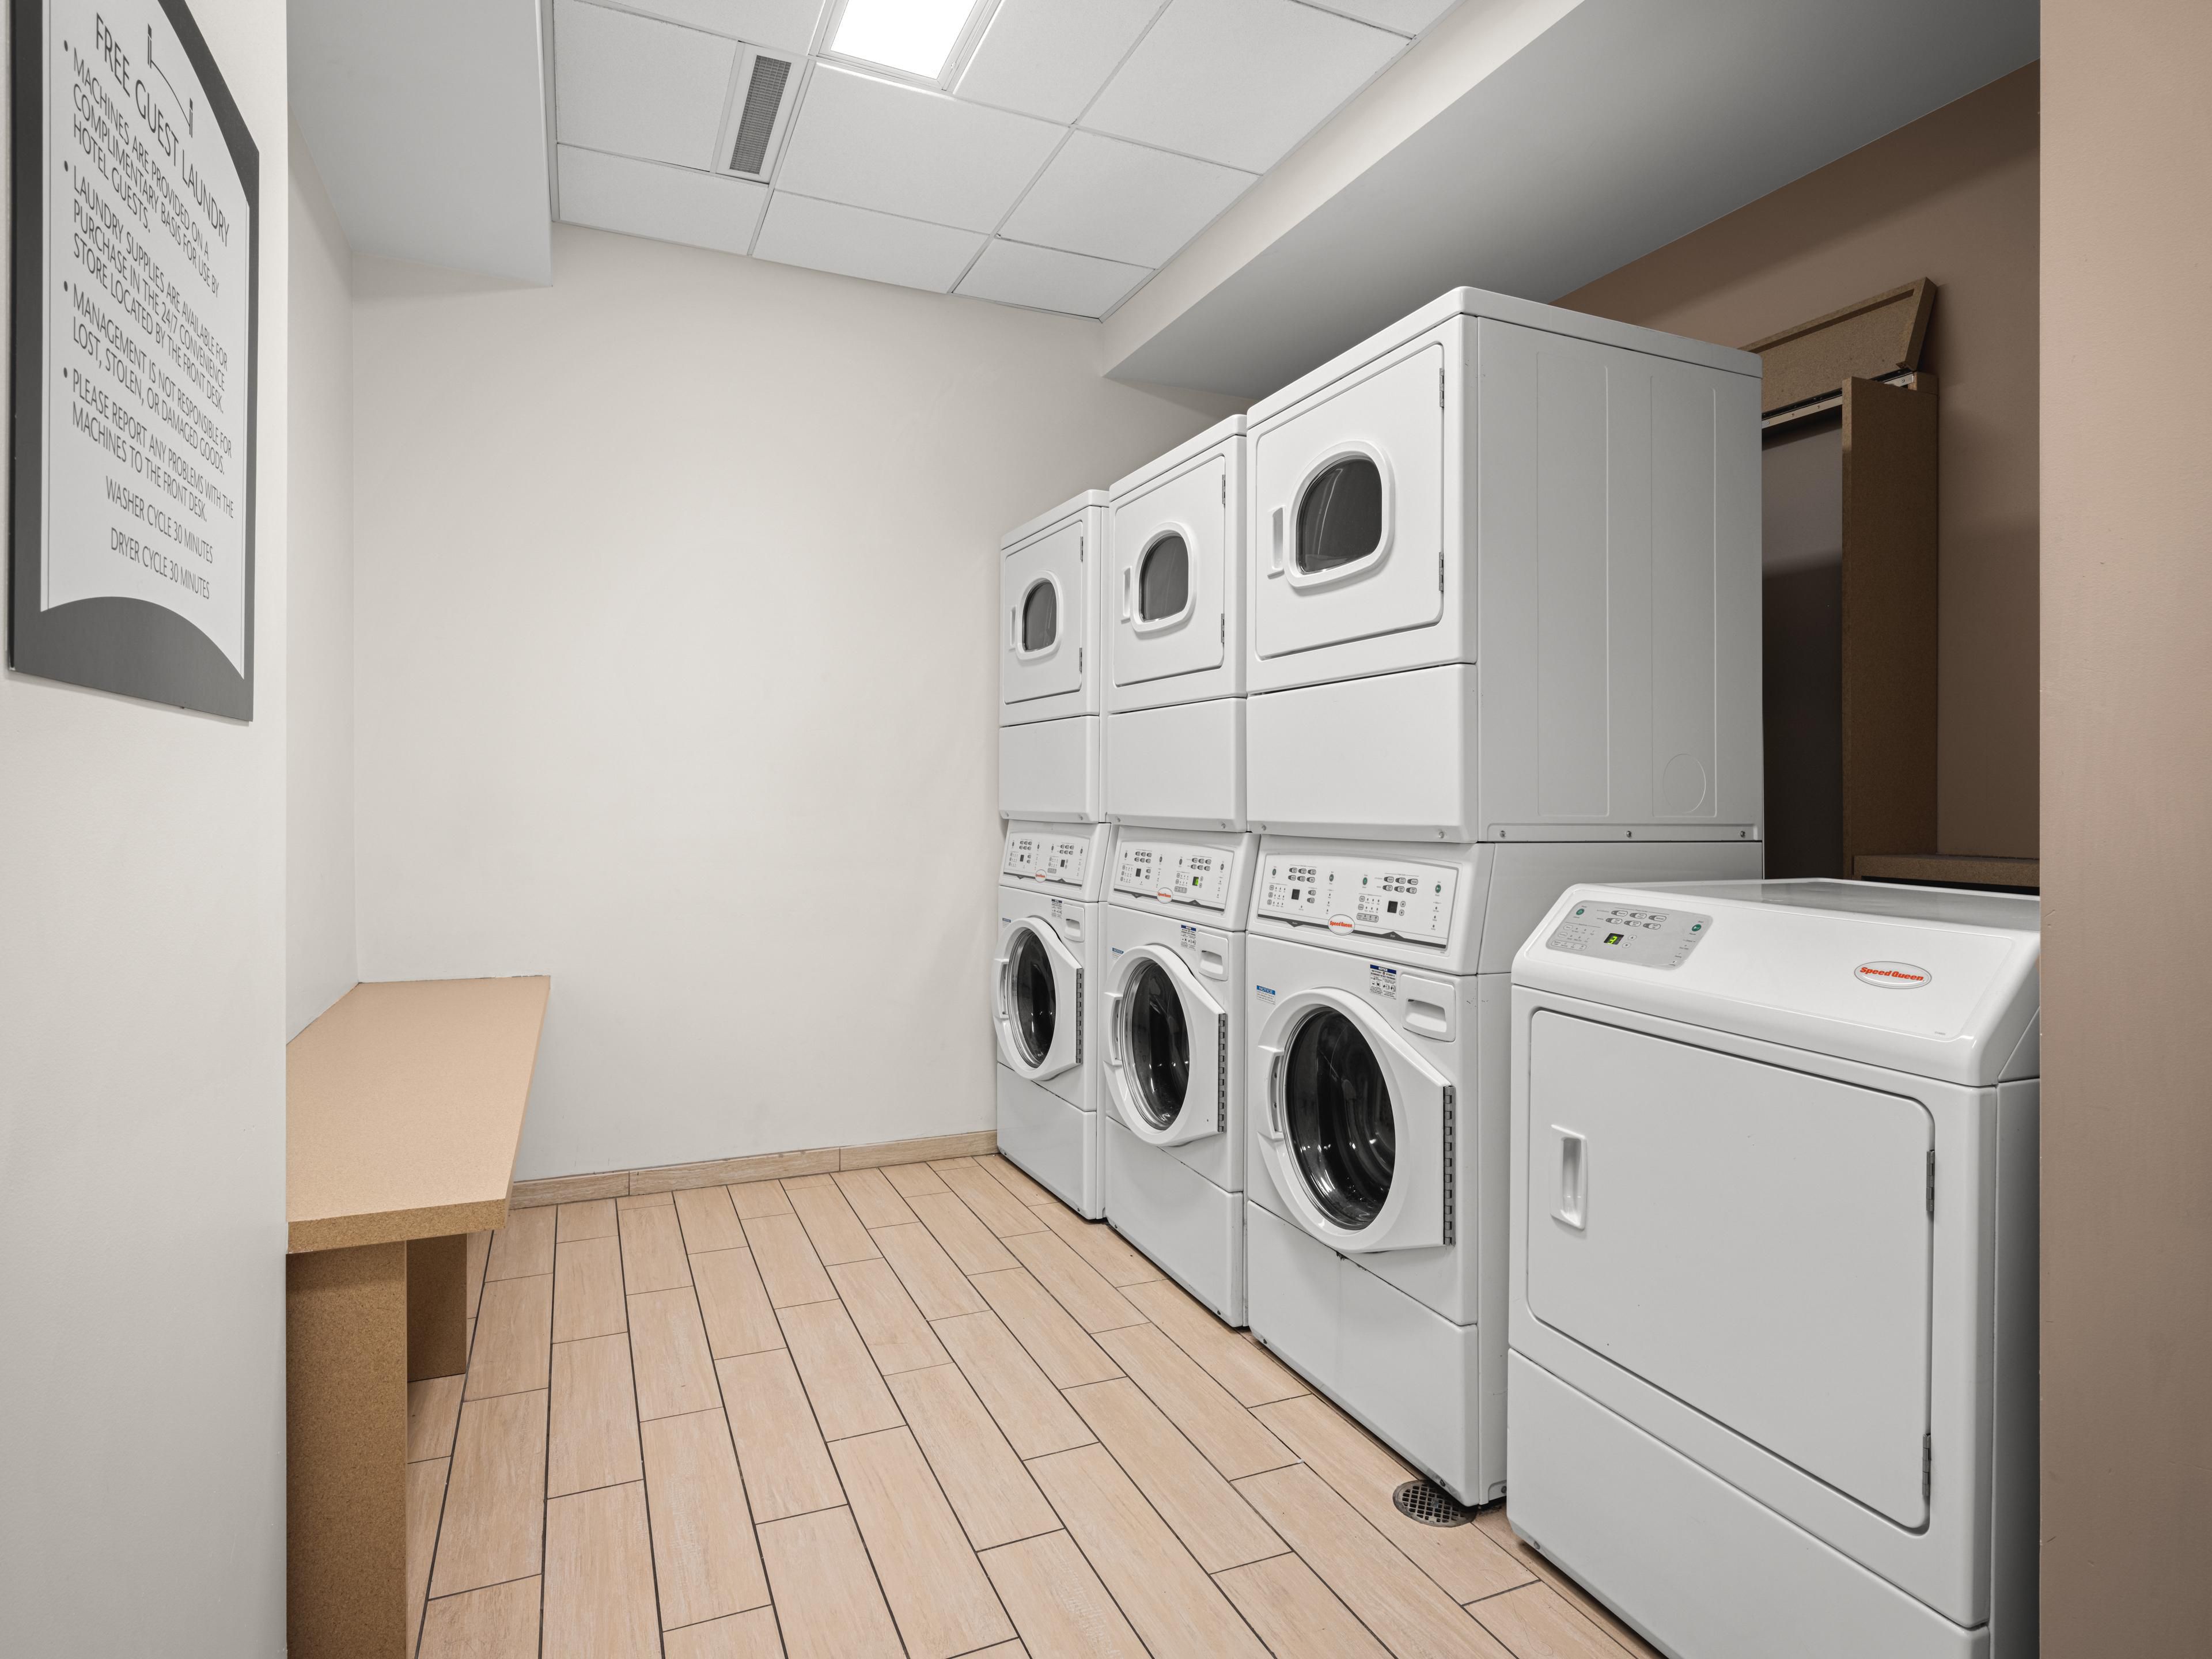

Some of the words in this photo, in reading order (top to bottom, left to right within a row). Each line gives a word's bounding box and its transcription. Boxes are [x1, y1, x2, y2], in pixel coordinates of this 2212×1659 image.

[73, 83, 159, 214] COMPLIMENTARY
[161, 200, 181, 246] BASIS
[183, 233, 197, 269] FOR
[198, 255, 210, 287] USE
[211, 274, 219, 298] BY
[74, 47, 130, 146] MACHINES
[131, 135, 150, 175] ARE
[151, 160, 190, 231] PROVIDED
[191, 221, 203, 252] ON
[203, 240, 209, 262] A
[74, 113, 109, 181] HOTEL
[111, 166, 150, 233] GUESTS.
[96, 12, 131, 98] FREE
[135, 79, 179, 167] GUEST
[182, 149, 230, 247] LAUNDRY
[73, 232, 108, 290] STORE
[111, 272, 153, 335] LOCATED
[156, 321, 166, 349] BY
[166, 334, 182, 369] THE
[183, 353, 206, 393] FRONT
[206, 379, 224, 414] DESK.
[74, 165, 124, 244] LAUNDRY
[126, 231, 165, 293] SUPPLIES
[166, 281, 180, 314] ARE
[181, 301, 215, 356] AVAILABLE
[215, 342, 228, 372] FOR
[74, 198, 128, 282] PURCHASE
[130, 264, 140, 295] IN
[142, 278, 160, 316] THE
[161, 301, 178, 334] 24/7
[179, 324, 225, 392] CONVENIENCE
[73, 283, 147, 374] MANAGEMENT
[149, 359, 156, 384] IS
[158, 368, 176, 402] NOT
[177, 388, 219, 446] RESPONSIBLE
[220, 431, 232, 459] FOR
[73, 316, 102, 369] LOST,
[105, 347, 144, 406] STOLEN,
[146, 387, 160, 416] OR
[162, 399, 198, 449] DAMAGED
[199, 437, 225, 475] GOODS.
[73, 368, 109, 420] PLEASE
[112, 401, 147, 448] REPORT
[149, 433, 166, 463] ANY
[168, 448, 203, 495] PROBLEMS
[204, 479, 221, 509] WITH
[222, 494, 234, 519] THE
[73, 400, 127, 463] MACHINES
[129, 445, 143, 474] TO
[145, 456, 161, 488] THE
[163, 471, 188, 506] FRONT
[189, 491, 207, 522] DESK.
[105, 475, 145, 521] WASHER
[147, 504, 172, 538] CYCLE
[173, 521, 183, 544] 30
[184, 528, 213, 564] MINUTES
[111, 527, 140, 563] DRYER
[142, 546, 168, 578] CYCLE
[169, 560, 179, 583] 30
[180, 566, 210, 600] MINUTES
[1860, 967, 1892, 976] Speed
[1892, 971, 1924, 981] Queen
